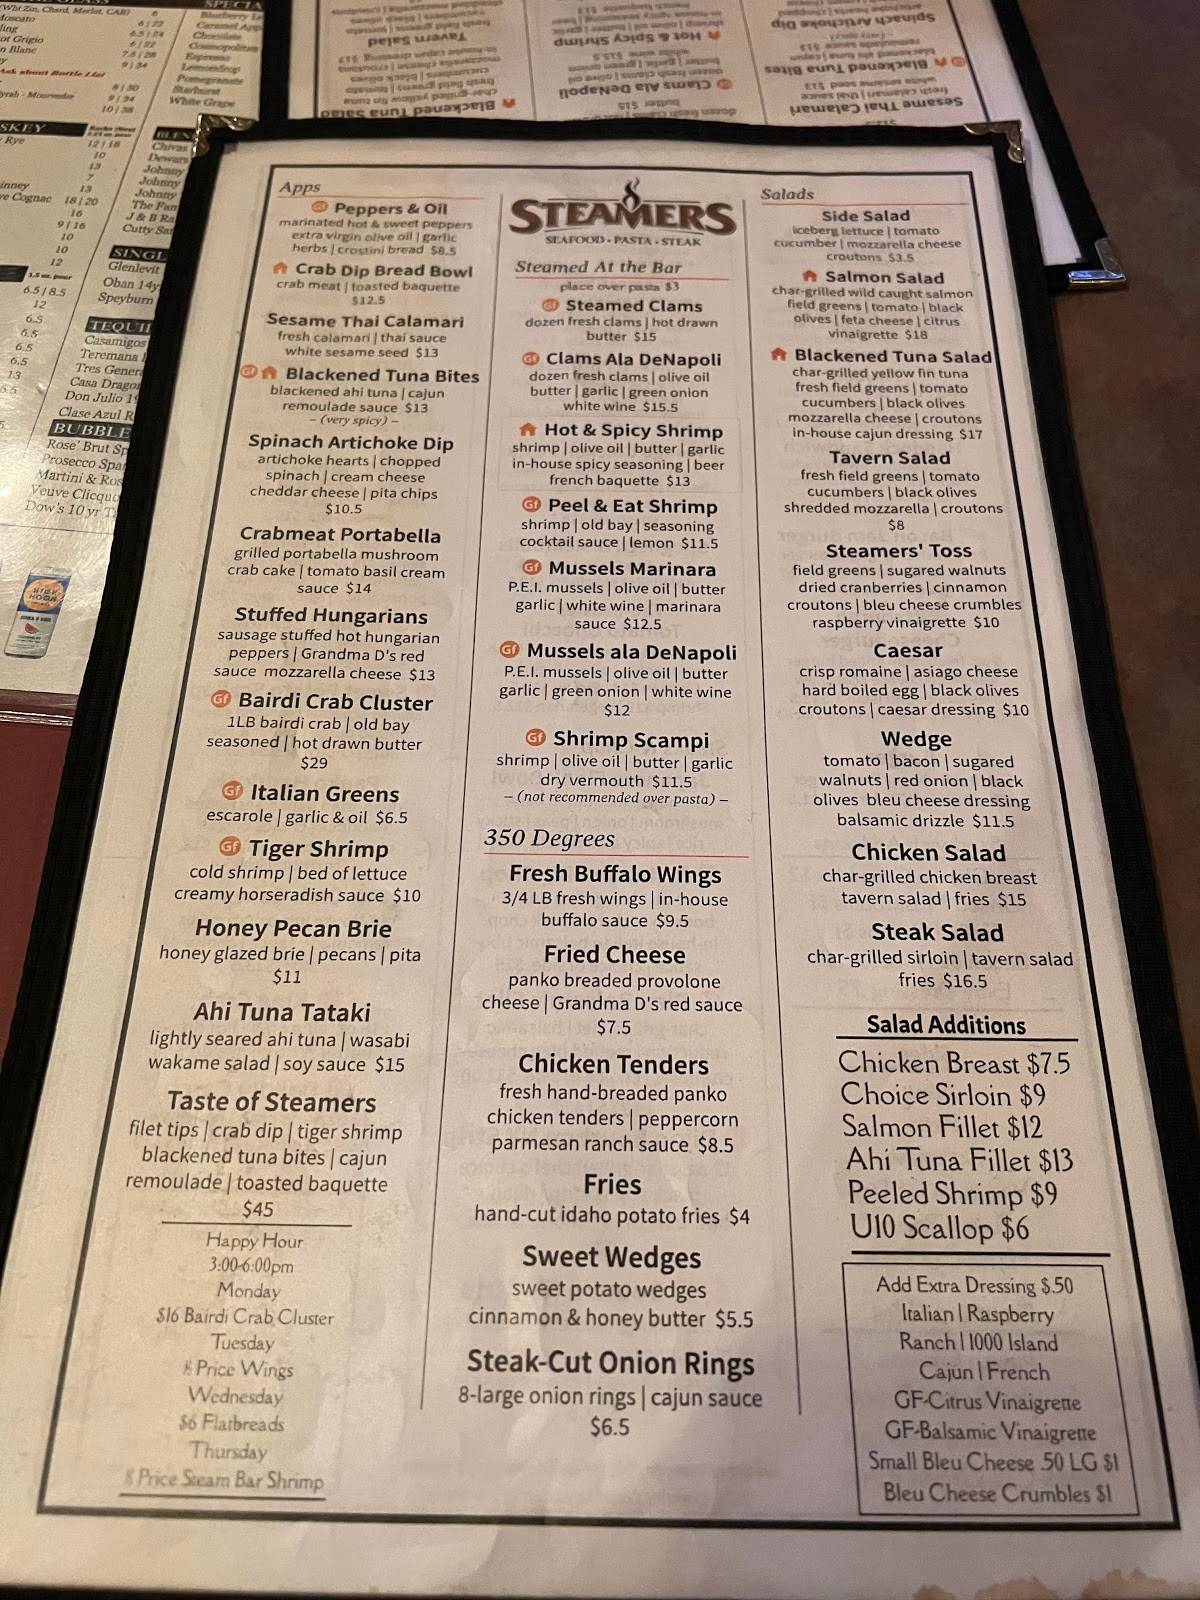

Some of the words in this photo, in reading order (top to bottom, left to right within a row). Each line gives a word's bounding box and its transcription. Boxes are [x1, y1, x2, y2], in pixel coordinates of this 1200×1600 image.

[771, 19, 796, 30] Dip
[800, 17, 871, 30] Artichoke
[875, 13, 935, 26] Spinach
[192, 31, 242, 41] Chocolate
[368, 35, 411, 47] Salad
[415, 32, 467, 44] Tavern
[554, 35, 609, 48] Shrimp
[614, 32, 654, 44] Spicy
[659, 33, 669, 42] &
[674, 31, 701, 42] Hot
[189, 41, 259, 52] Cosmopolitan
[185, 53, 231, 63] Espresso
[181, 63, 241, 74] Lemondrop
[764, 65, 803, 76] Bites
[807, 63, 845, 74] Tuna
[849, 59, 928, 74] Blackened
[176, 75, 245, 86] Pomegranate
[664, 80, 711, 91] Clams
[559, 84, 631, 99] DeNapoli
[635, 83, 660, 93] Ala
[169, 96, 203, 105] White
[203, 98, 236, 108] Grape
[864, 101, 900, 112] Thai
[903, 97, 963, 109] Sesame
[369, 108, 407, 118] Tuna
[413, 101, 496, 118] Blackened
[789, 103, 860, 116] Calamari
[152, 142, 189, 152] Chivas
[143, 165, 186, 177] Johnny
[139, 177, 182, 189] Johnny
[278, 182, 320, 195] Apps
[12, 194, 52, 204] Cognac
[134, 188, 178, 200] Johnny
[761, 188, 814, 200] Salads
[335, 203, 403, 217] Peppers
[407, 203, 420, 214] &
[424, 203, 447, 215] Oil
[509, 199, 737, 236] STEAMERS
[826, 252, 882, 262] croutons
[888, 252, 914, 264] $3.5
[296, 263, 336, 275] Crab
[341, 265, 369, 279] Dip
[375, 264, 425, 276] Bread
[430, 265, 472, 278] Bowl
[515, 260, 589, 274] Steamed
[594, 261, 614, 272] At
[620, 260, 646, 273] the
[652, 261, 682, 273] Bar
[103, 277, 137, 289] Oban
[826, 270, 891, 283] Salmon
[896, 272, 944, 284] Salad
[98, 292, 154, 305] Speyburn
[352, 296, 385, 306] $12.5
[84, 335, 146, 348] Casamigos
[586, 330, 627, 341] butter
[634, 330, 656, 342] $15
[80, 348, 140, 362] Teremana
[285, 346, 322, 357] white
[325, 349, 375, 357] sesame
[377, 348, 409, 357] seed
[416, 346, 438, 358] $13
[75, 363, 101, 374] Tres
[69, 377, 98, 388] Casa
[65, 390, 91, 402] Don
[92, 393, 123, 404] Julio
[58, 407, 91, 418] Clase
[92, 409, 122, 420] Azul
[47, 440, 82, 451] Rose'
[83, 442, 109, 454] Brut
[41, 454, 96, 469] Prosecco
[37, 469, 83, 484] Martini
[85, 473, 97, 485] &
[550, 474, 593, 485] french
[667, 475, 690, 487] $13
[31, 485, 69, 498] Veuve
[25, 500, 64, 514] Dow's
[68, 504, 85, 516] 10
[888, 519, 904, 531] $8
[241, 526, 335, 541] Crabmeat
[341, 528, 440, 543] Portabella
[826, 544, 922, 558] Steamers'
[929, 544, 972, 558] Toss
[874, 643, 943, 658] Caesar
[239, 692, 300, 709] Bairdi
[306, 693, 353, 709] Crab
[360, 694, 433, 711] Cluster
[554, 730, 627, 751] Shrimp
[632, 732, 708, 753] Scampi
[881, 730, 951, 751] Wedge
[301, 756, 327, 770] $29
[484, 828, 525, 846] 350
[531, 829, 615, 851] Degrees
[250, 839, 305, 861] Tiger
[310, 840, 388, 862] Shrimp
[175, 890, 235, 904] creamy
[239, 886, 333, 903] horseradish
[338, 892, 384, 902] sauce
[393, 888, 420, 904] $10
[193, 1001, 231, 1021] Ahi
[238, 1003, 293, 1021] Tuna
[301, 1003, 370, 1022] Tataki
[868, 1013, 923, 1033] Salad
[928, 1014, 1026, 1035] Additions
[519, 1053, 609, 1074] Chicken
[617, 1054, 709, 1075] Tenders
[839, 1050, 939, 1073] Chicken
[946, 1051, 1020, 1074] Breast
[1027, 1052, 1070, 1077] $7.5
[585, 1173, 641, 1195] Fries
[242, 1199, 273, 1219] $45
[475, 1204, 556, 1222] hand-cut
[561, 1205, 611, 1223] idaho
[618, 1208, 676, 1227] potato
[682, 1206, 720, 1224] fries
[730, 1206, 750, 1226] $4
[851, 1213, 895, 1238] U10
[903, 1214, 993, 1245] Scallop
[1002, 1215, 1029, 1242] $6
[206, 1230, 259, 1251] Happy
[262, 1232, 304, 1252] Hour
[209, 1256, 293, 1275] 3:00-6:00pm
[217, 1281, 281, 1300] Monday
[877, 1275, 912, 1293] Add
[917, 1275, 961, 1293] Extra
[965, 1275, 1036, 1298] Dressing
[1041, 1277, 1073, 1295] $.50
[156, 1307, 180, 1324] $16
[184, 1307, 229, 1324] Bairdi
[232, 1307, 275, 1327] Crab
[277, 1308, 334, 1325] Cluster
[211, 1333, 275, 1352] Tuesday
[467, 1348, 592, 1374] Steak-Cut
[599, 1350, 676, 1374] Onion
[685, 1351, 754, 1382] Rings
[894, 1390, 982, 1410] GF-Citrus
[985, 1390, 1081, 1415] Vinaigrette
[591, 1416, 629, 1437] $6.5
[884, 1481, 924, 1502] Bleu
[929, 1482, 997, 1503] Cheese
[1000, 1482, 1091, 1503] Crumbles
[1096, 1483, 1112, 1503] $1
